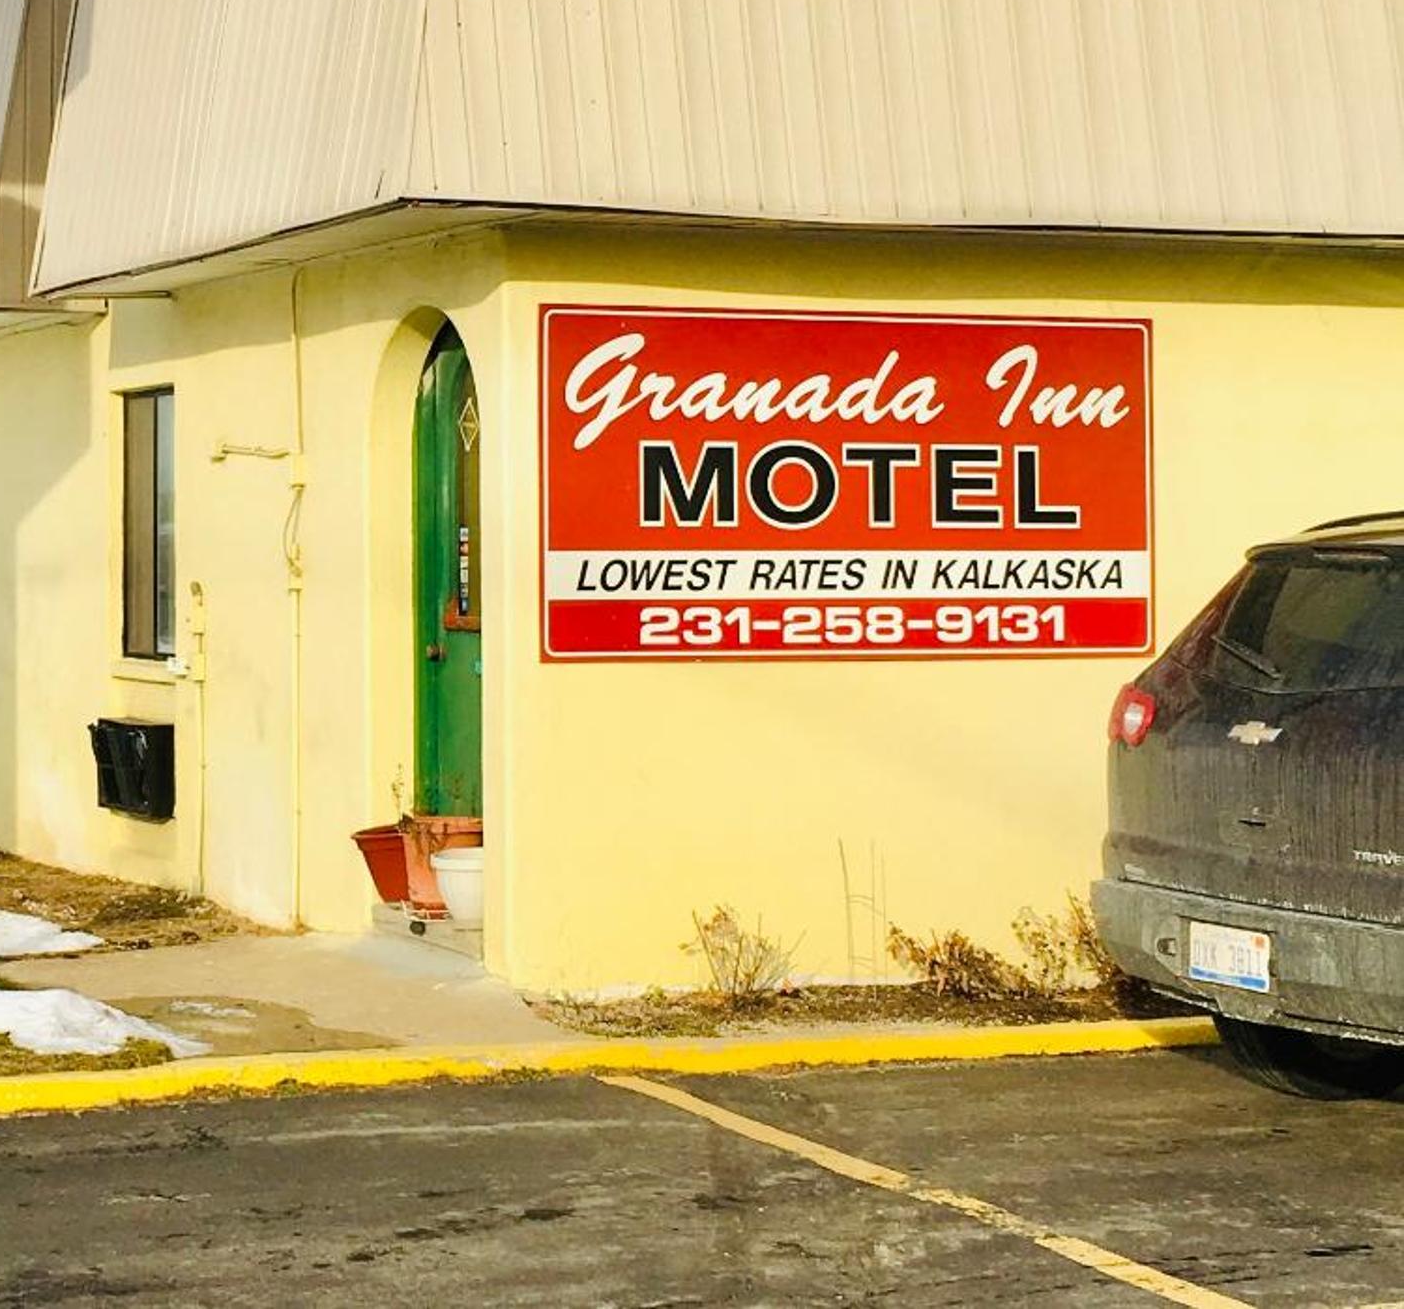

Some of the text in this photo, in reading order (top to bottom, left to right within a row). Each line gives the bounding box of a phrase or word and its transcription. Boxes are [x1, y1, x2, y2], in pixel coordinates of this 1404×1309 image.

[565, 333, 1130, 450] Granada Inn
[640, 440, 1081, 529] MOTEL
[576, 558, 1123, 592] LOWEST RATES IN KALKASKA
[639, 605, 1066, 645] 231-258-9131
